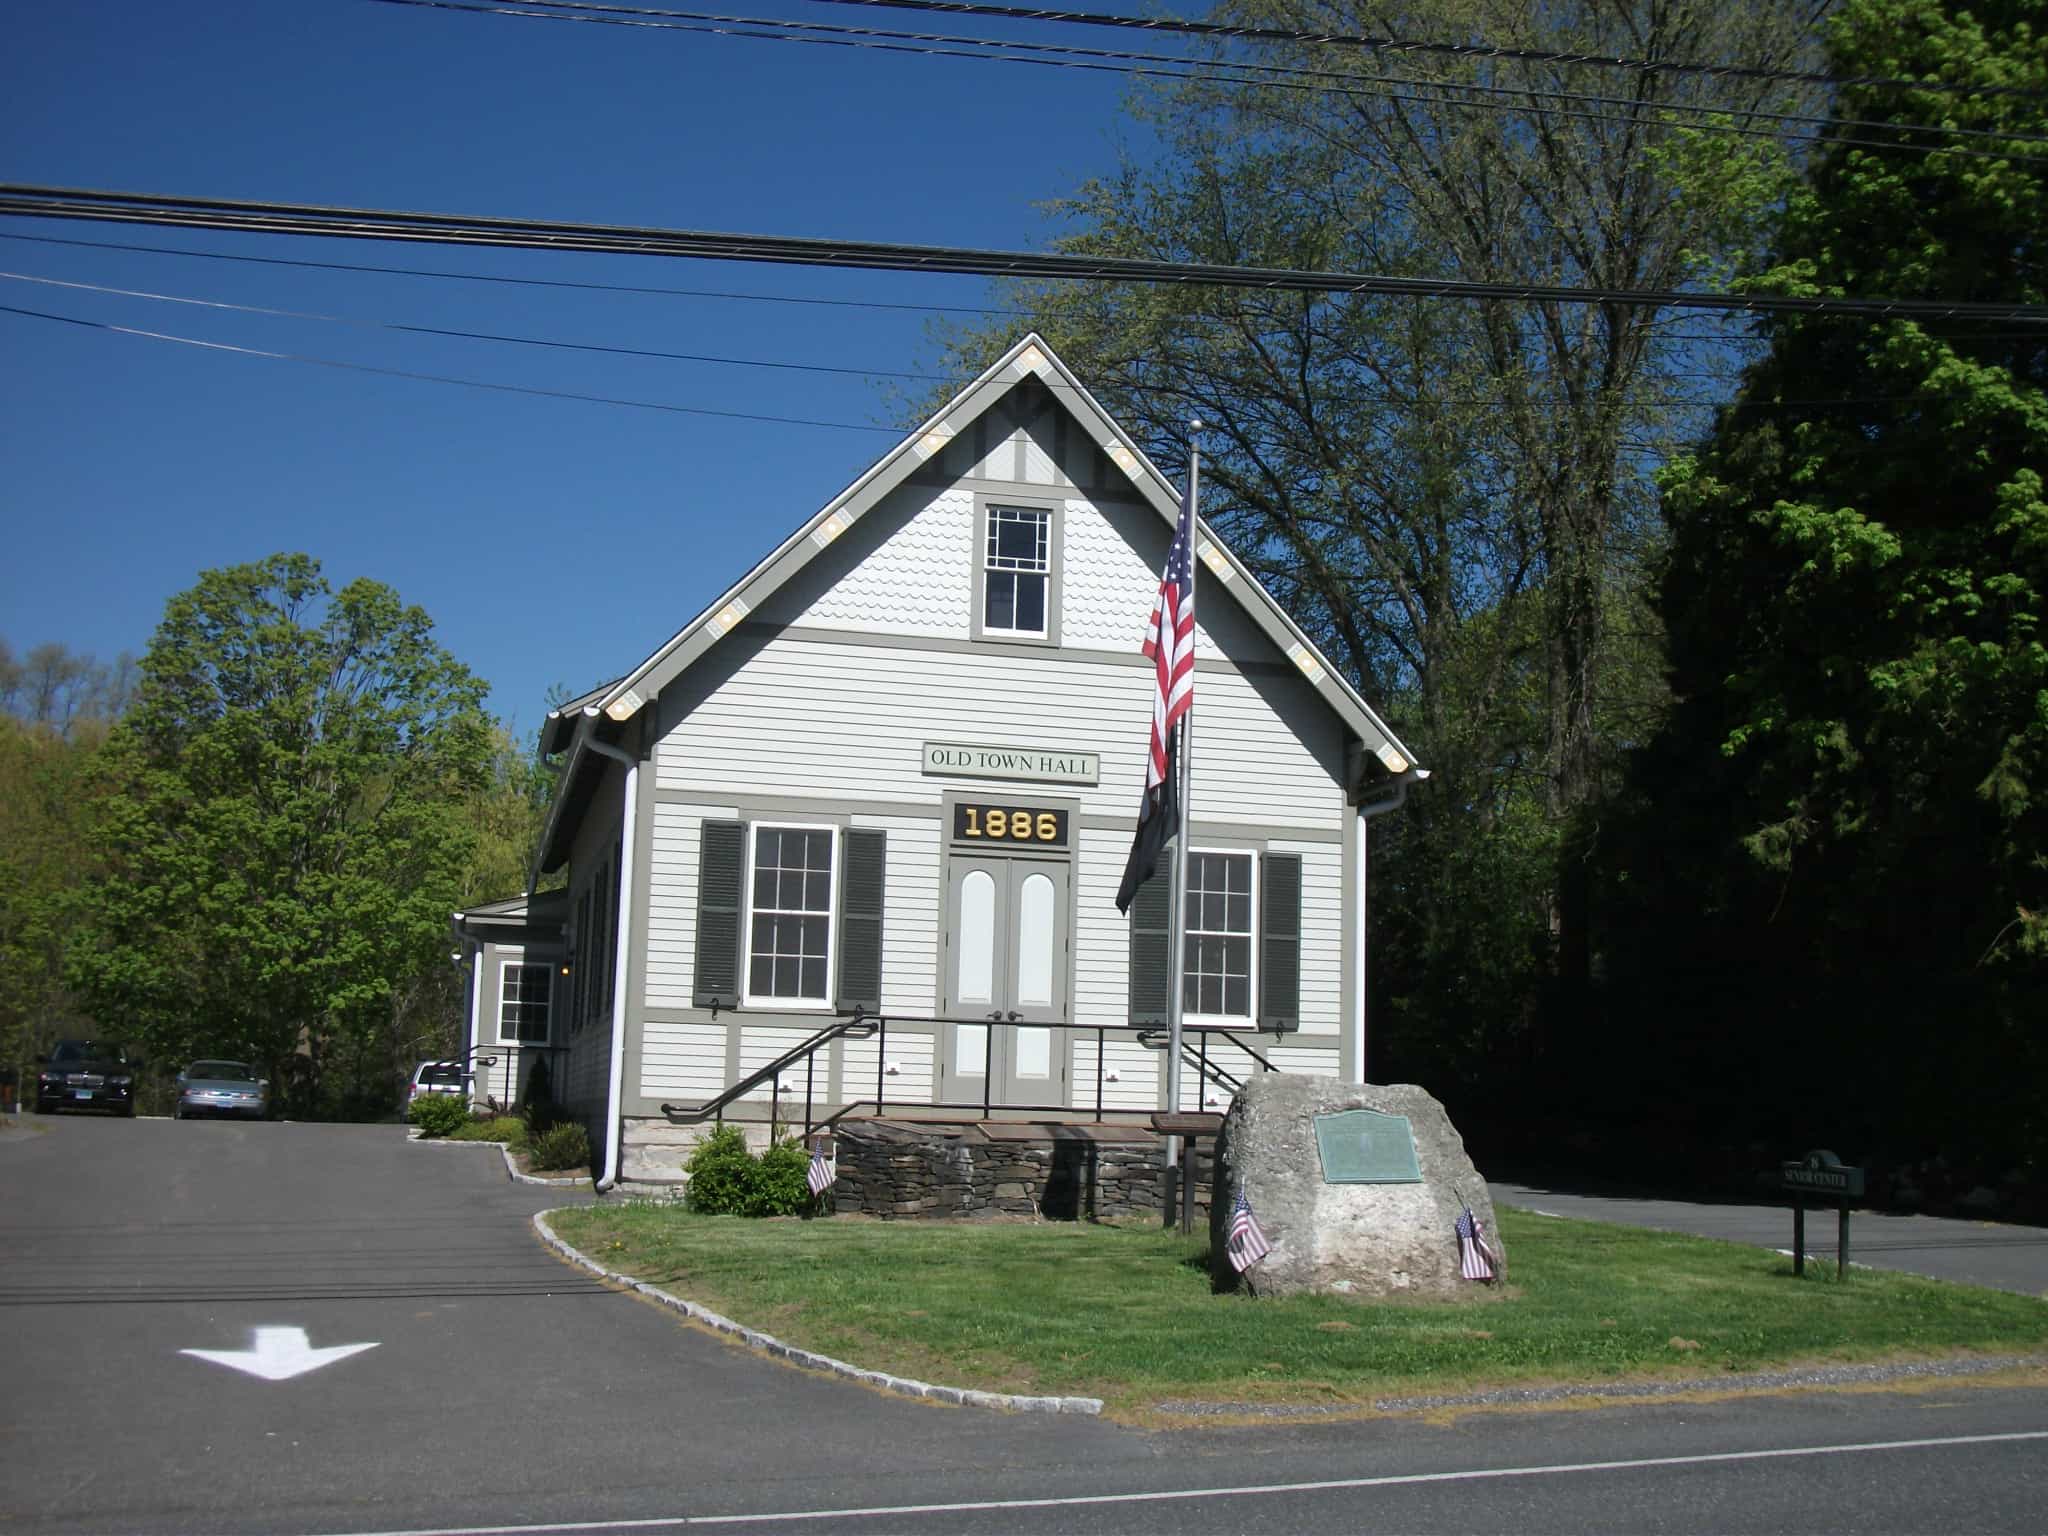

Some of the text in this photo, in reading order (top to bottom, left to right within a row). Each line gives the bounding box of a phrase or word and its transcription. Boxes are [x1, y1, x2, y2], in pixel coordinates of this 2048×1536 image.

[931, 749, 1092, 775] OLD TOWN HALL
[965, 807, 1057, 840] 1886
